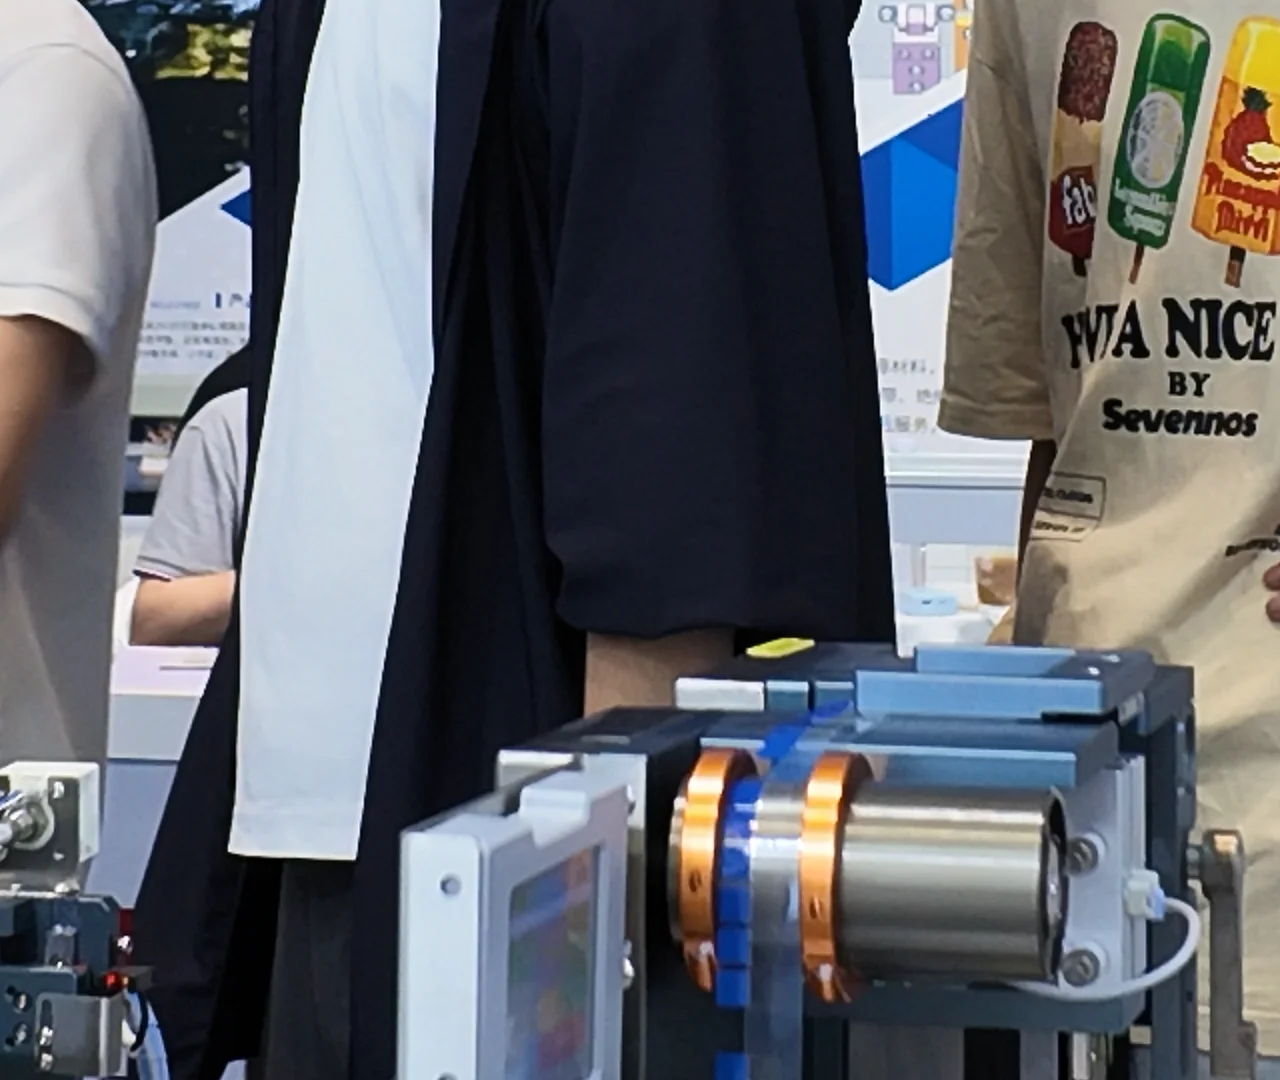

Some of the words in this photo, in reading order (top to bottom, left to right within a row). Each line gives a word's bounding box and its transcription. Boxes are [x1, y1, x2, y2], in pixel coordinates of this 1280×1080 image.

[1162, 298, 1276, 362] NICE
[1168, 370, 1211, 397] BY
[1101, 398, 1259, 437] Sevennos
